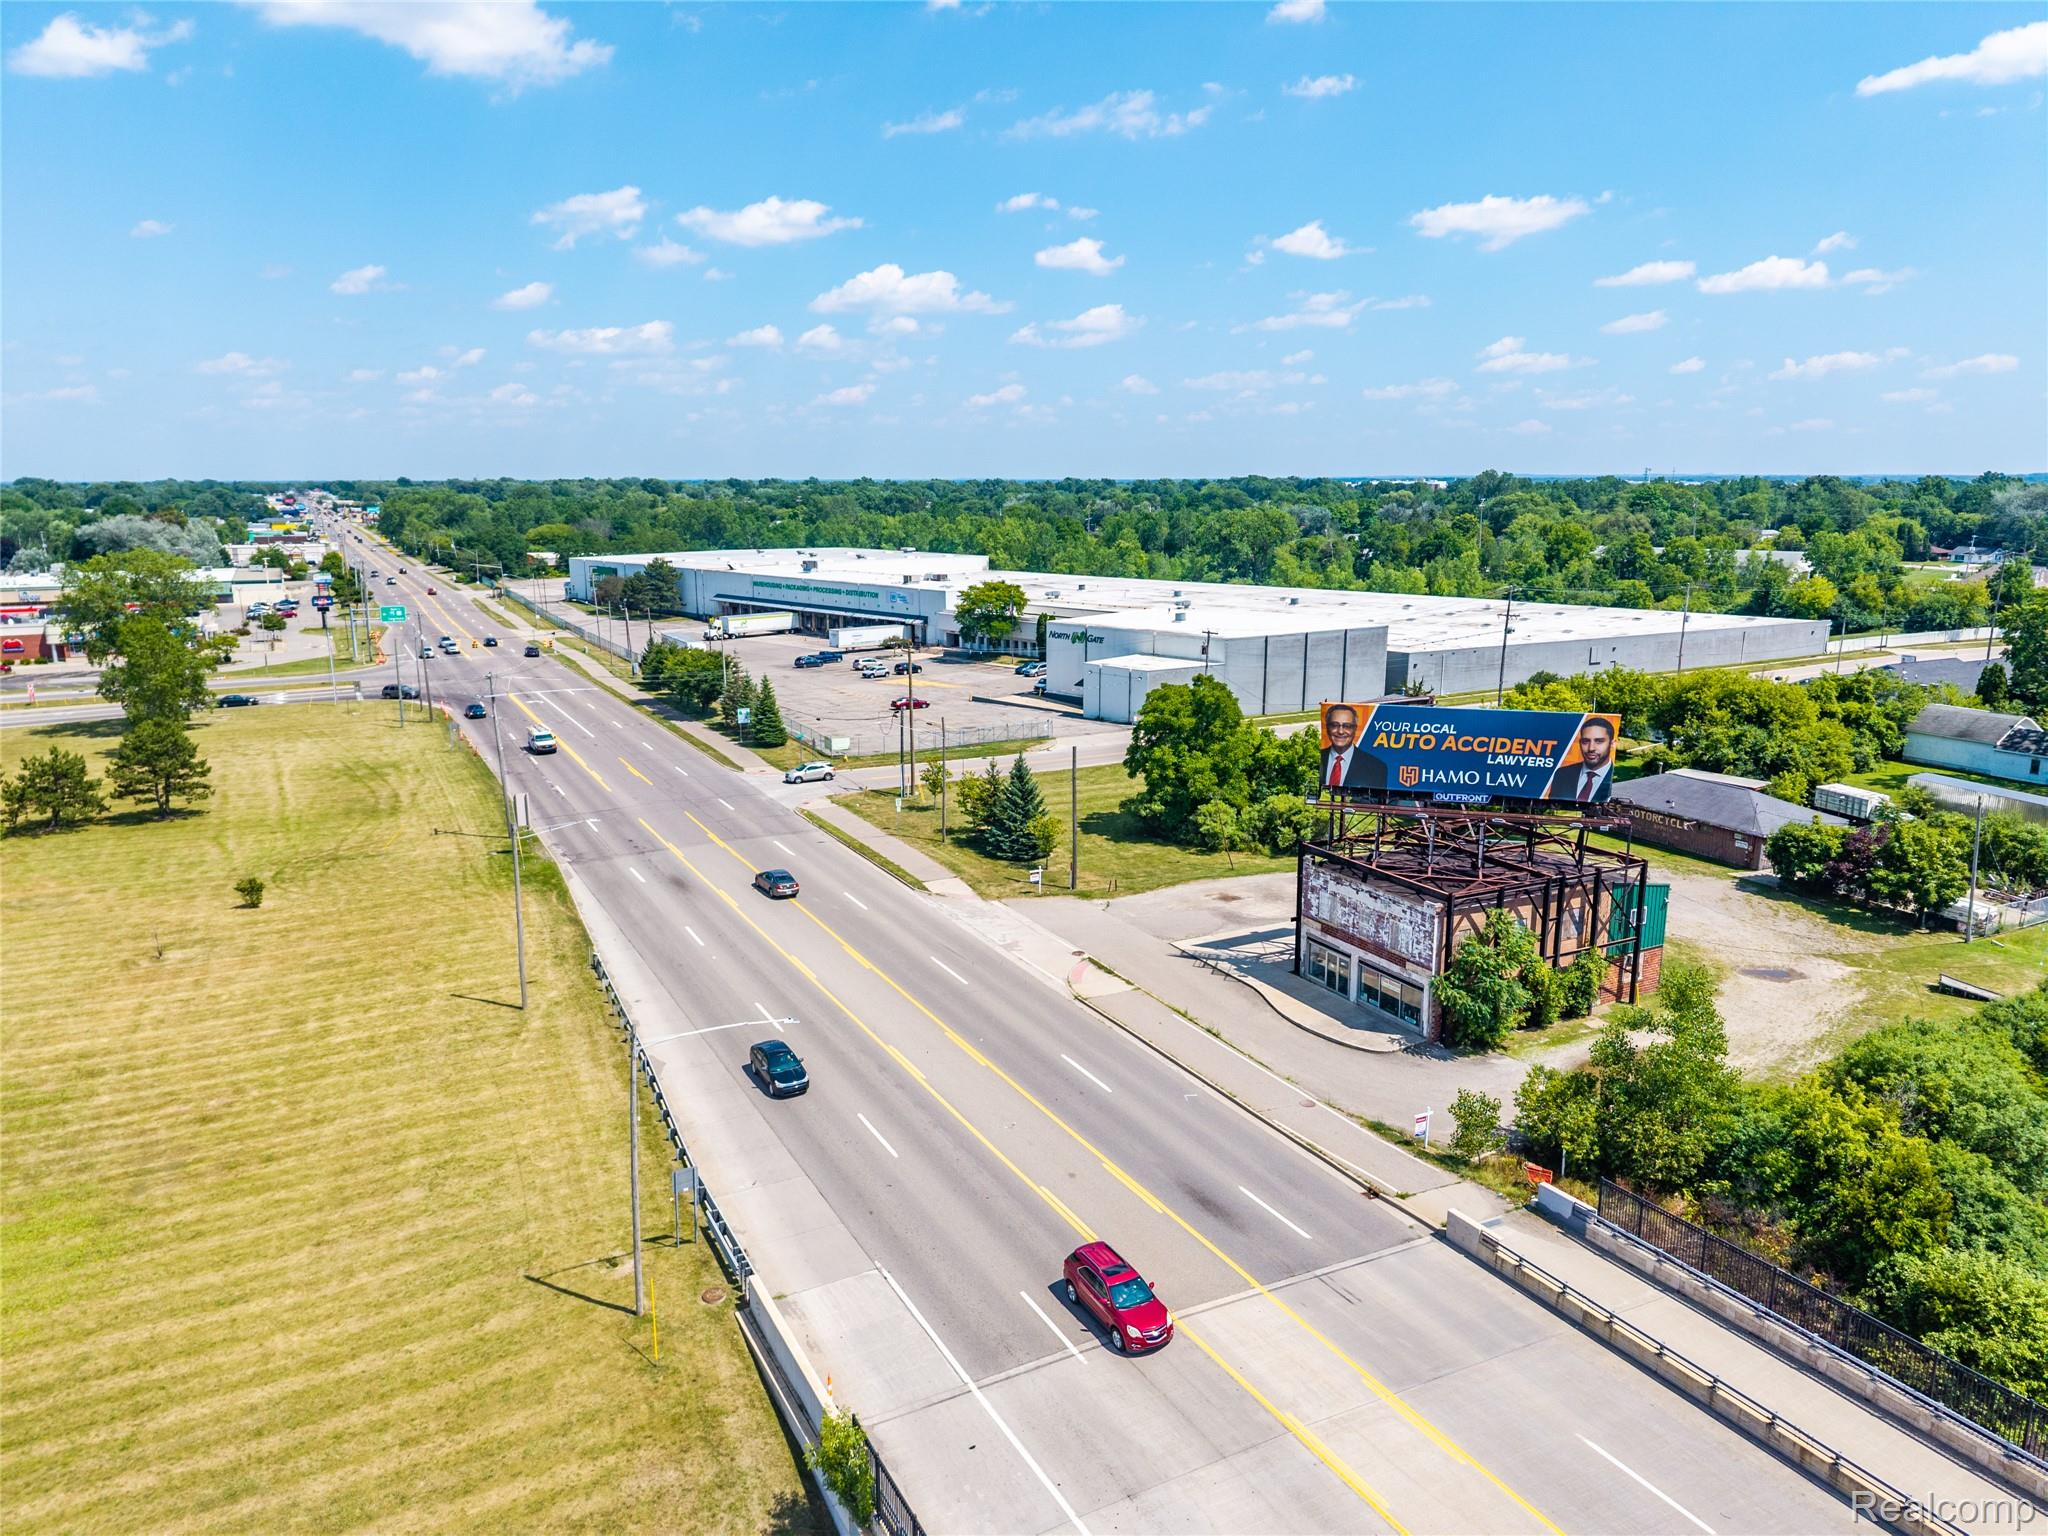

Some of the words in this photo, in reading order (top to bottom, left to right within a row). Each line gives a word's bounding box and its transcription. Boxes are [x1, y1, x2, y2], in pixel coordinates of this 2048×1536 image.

[846, 589, 879, 598] DISTRIBUTION
[1374, 720, 1410, 732] YOUR
[1413, 723, 1457, 734] LOCAL
[1373, 732, 1436, 750] AUTO
[1441, 735, 1557, 755] ACCIDENT
[1487, 754, 1555, 769] LAWYERS
[1422, 768, 1480, 785] HAMO
[1486, 772, 1527, 788] LAW
[1435, 793, 1489, 802] OUTFRONT
